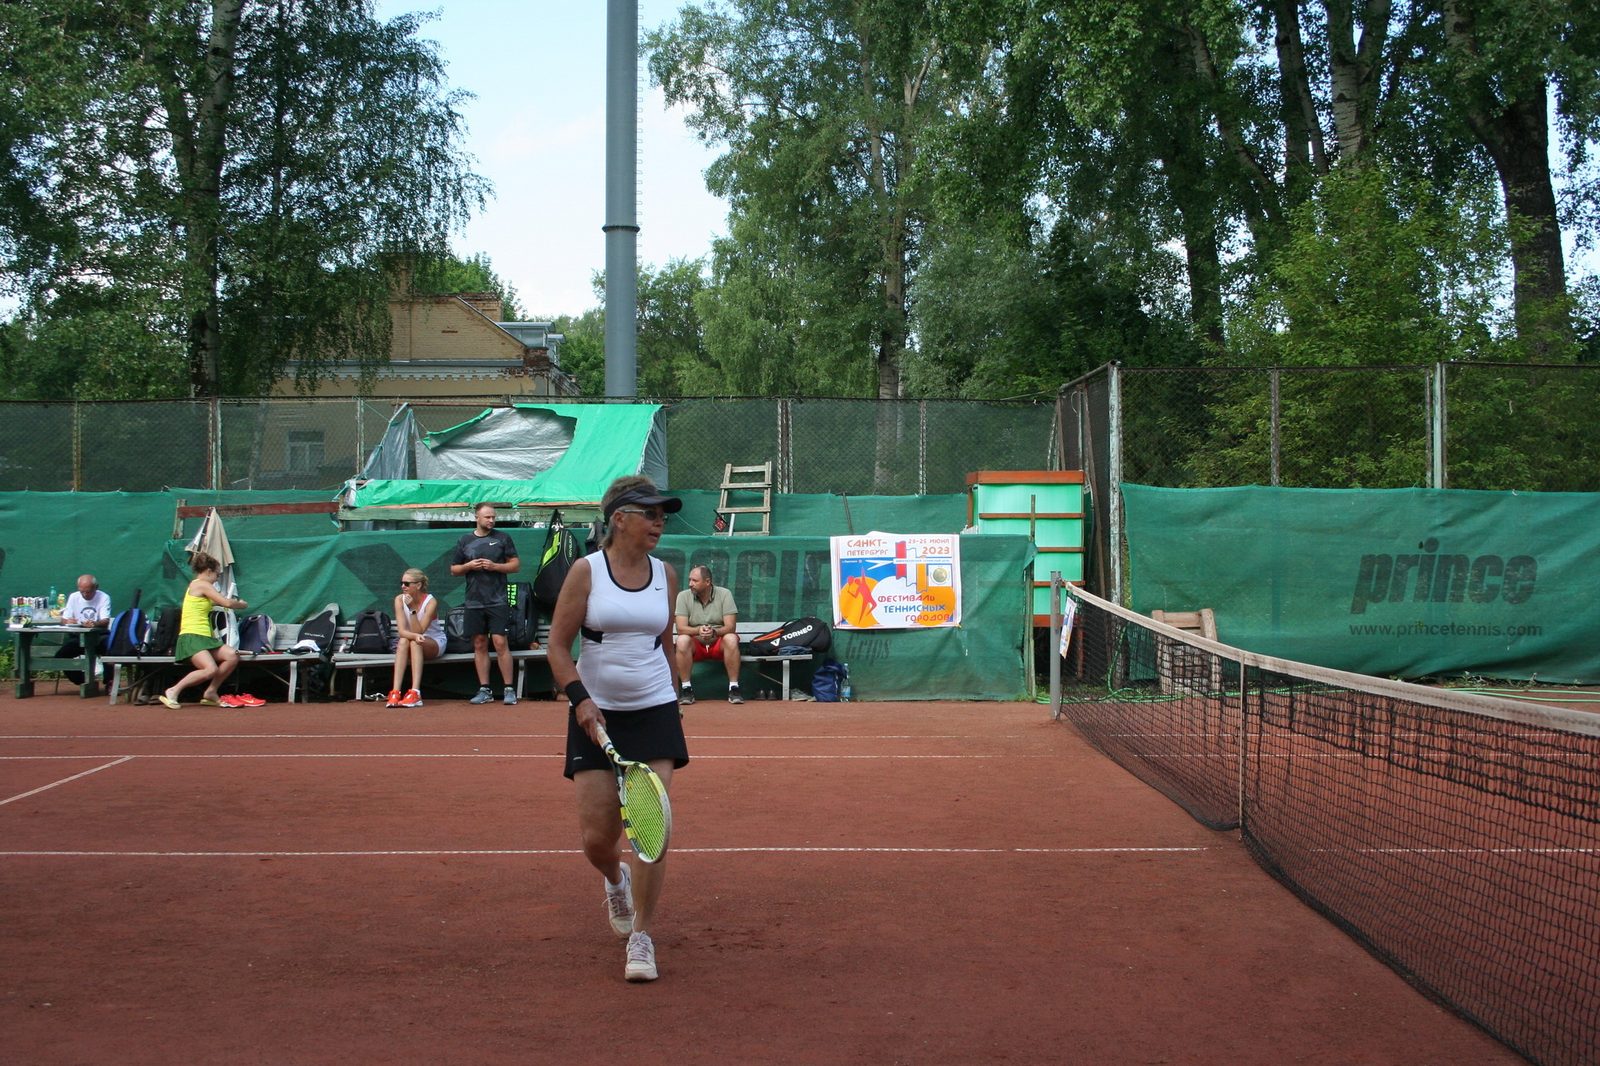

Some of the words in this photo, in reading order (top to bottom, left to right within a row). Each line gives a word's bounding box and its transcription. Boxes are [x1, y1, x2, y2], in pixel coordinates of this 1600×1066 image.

[847, 538, 888, 548] САНКТ-
[922, 546, 950, 555] 2023
[1350, 537, 1538, 615] prince
[877, 593, 936, 603] ФЕСТИВАЛЬ
[884, 604, 946, 614] ТЕННИСНЫХ
[905, 614, 950, 622] ГОРОДОВ
[782, 624, 813, 642] TORNEO
[1350, 622, 1543, 638] www.princetennis.com
